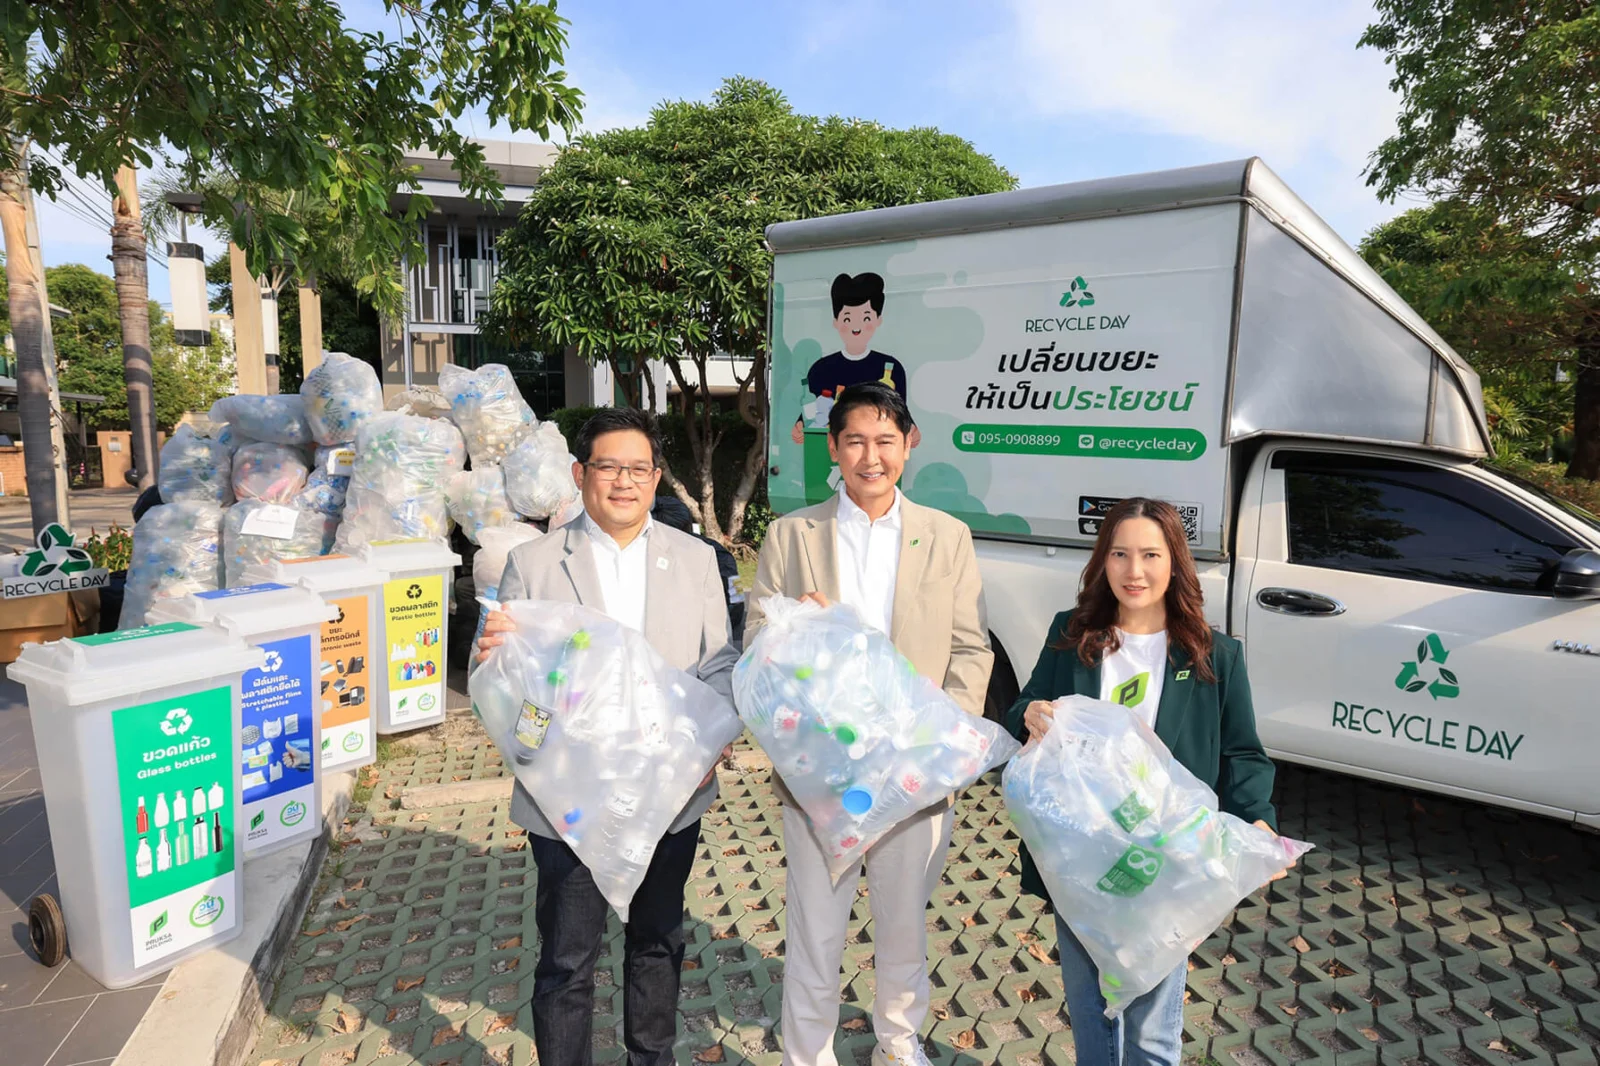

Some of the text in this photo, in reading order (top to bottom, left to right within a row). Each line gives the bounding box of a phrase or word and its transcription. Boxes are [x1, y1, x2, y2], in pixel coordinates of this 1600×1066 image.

[1025, 314, 1130, 333] RECYCLE DAY
[997, 341, 1159, 373] เปลี่ยนขยะ
[964, 380, 1200, 412] ให้เป็นประโยชน์
[978, 432, 1061, 446] 095-0908899
[1098, 436, 1197, 453] @recycleday
[4, 573, 107, 597] RECYCLE DAY
[389, 600, 439, 613] ขวดพลาสติก
[414, 611, 437, 619] bottles
[1331, 700, 1525, 761] RECYCLE DAY
[142, 735, 212, 763] ขวดแก้ว
[136, 751, 217, 780] Glass bottles
